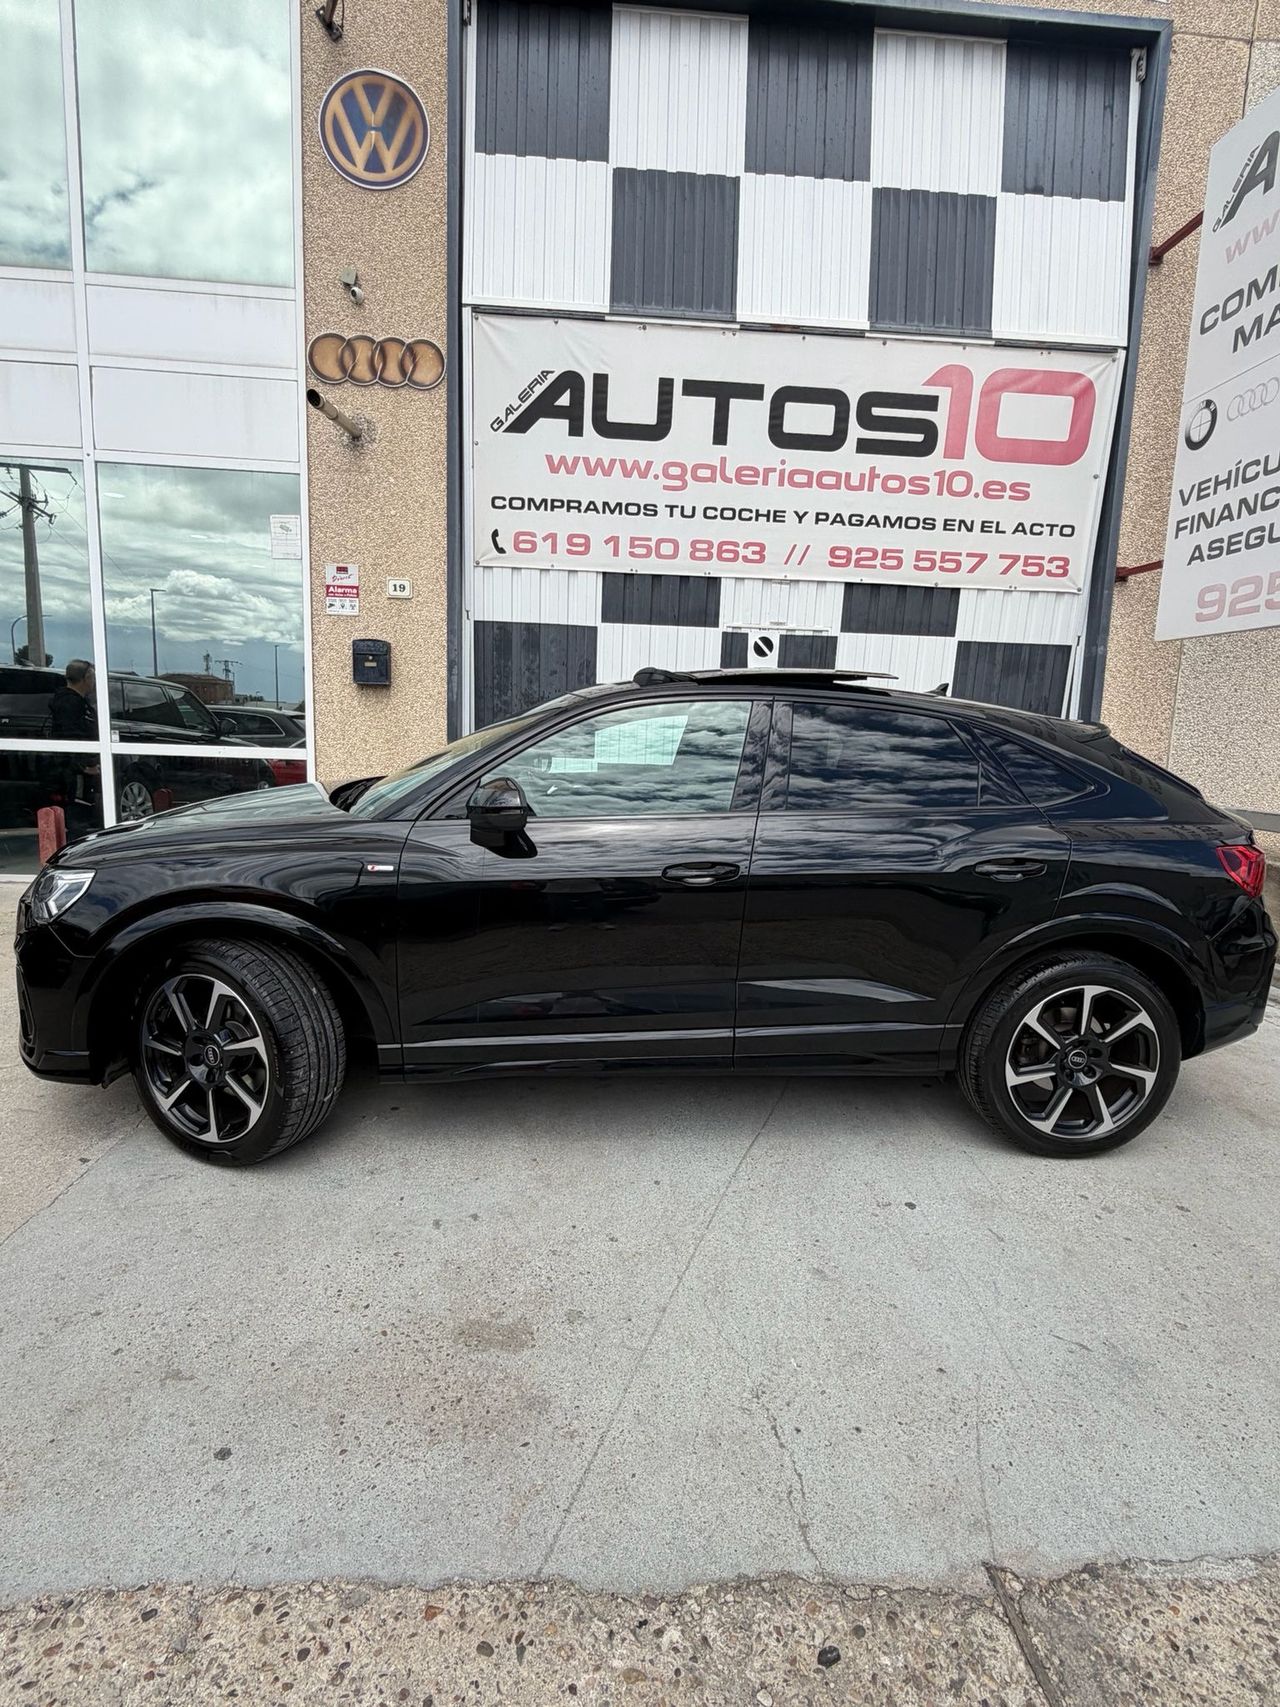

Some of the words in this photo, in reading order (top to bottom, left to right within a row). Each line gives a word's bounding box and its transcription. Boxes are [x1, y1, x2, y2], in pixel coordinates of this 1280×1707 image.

[1200, 264, 1280, 335] COM
[490, 370, 555, 432] GALERIA
[545, 454, 1031, 501] www.galeriaautos10.es
[491, 496, 658, 517] COMPRAMOS
[665, 504, 696, 519] TU
[703, 506, 787, 523] COCHE
[793, 510, 809, 524] Y
[814, 512, 937, 531] PAGAMOS
[942, 519, 974, 533] EN
[980, 520, 1007, 534] EL
[1011, 522, 1076, 538] ACTO
[1174, 486, 1280, 539] FINANC
[513, 530, 591, 556] 619
[603, 535, 680, 560] 150
[689, 539, 766, 564] 863
[828, 545, 904, 570] 925
[913, 550, 988, 574] 557
[998, 553, 1071, 578] 753
[328, 586, 358, 594] Alarma
[393, 583, 406, 593] 19
